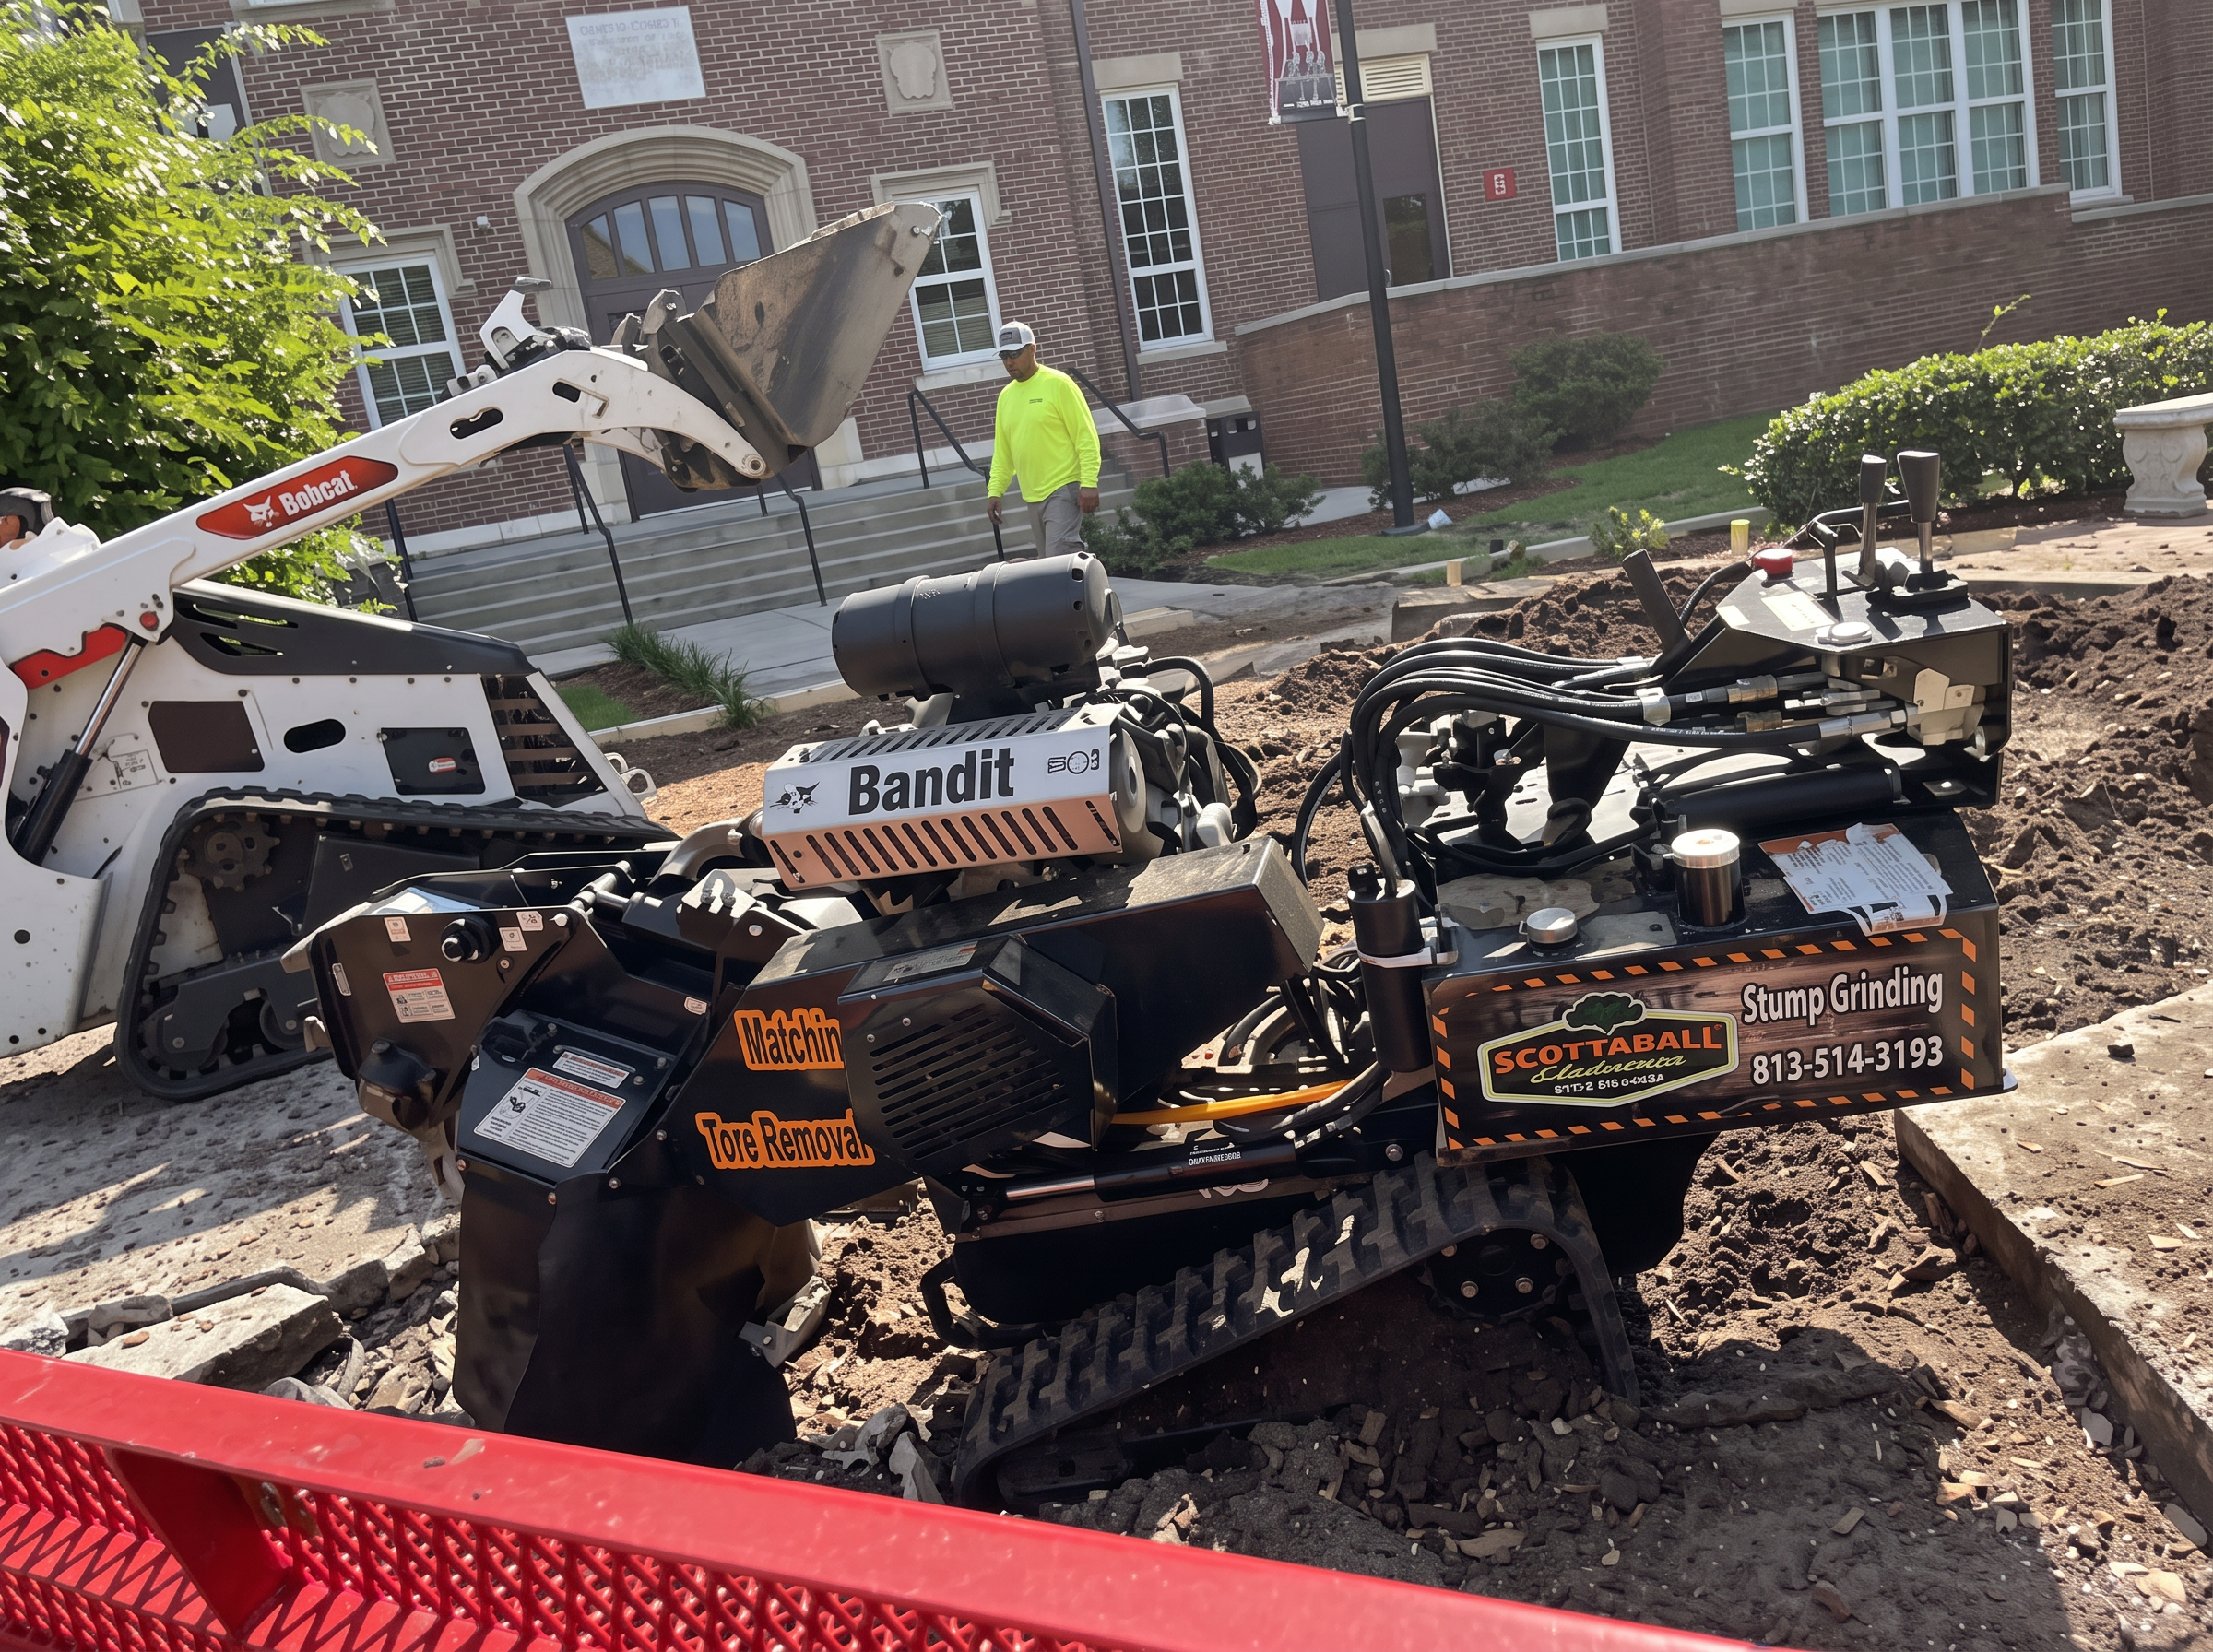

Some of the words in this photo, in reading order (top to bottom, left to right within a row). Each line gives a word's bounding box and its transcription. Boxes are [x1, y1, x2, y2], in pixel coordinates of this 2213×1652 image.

[278, 469, 357, 516] Bobcat
[848, 748, 1014, 816] Bandit
[1743, 985, 1825, 1026] Stump
[1830, 966, 1943, 1014] Grinding
[1494, 1026, 1722, 1075] SCOTTABALL
[1753, 1035, 1944, 1085] 813-514-3193
[701, 1118, 759, 1162] Tore
